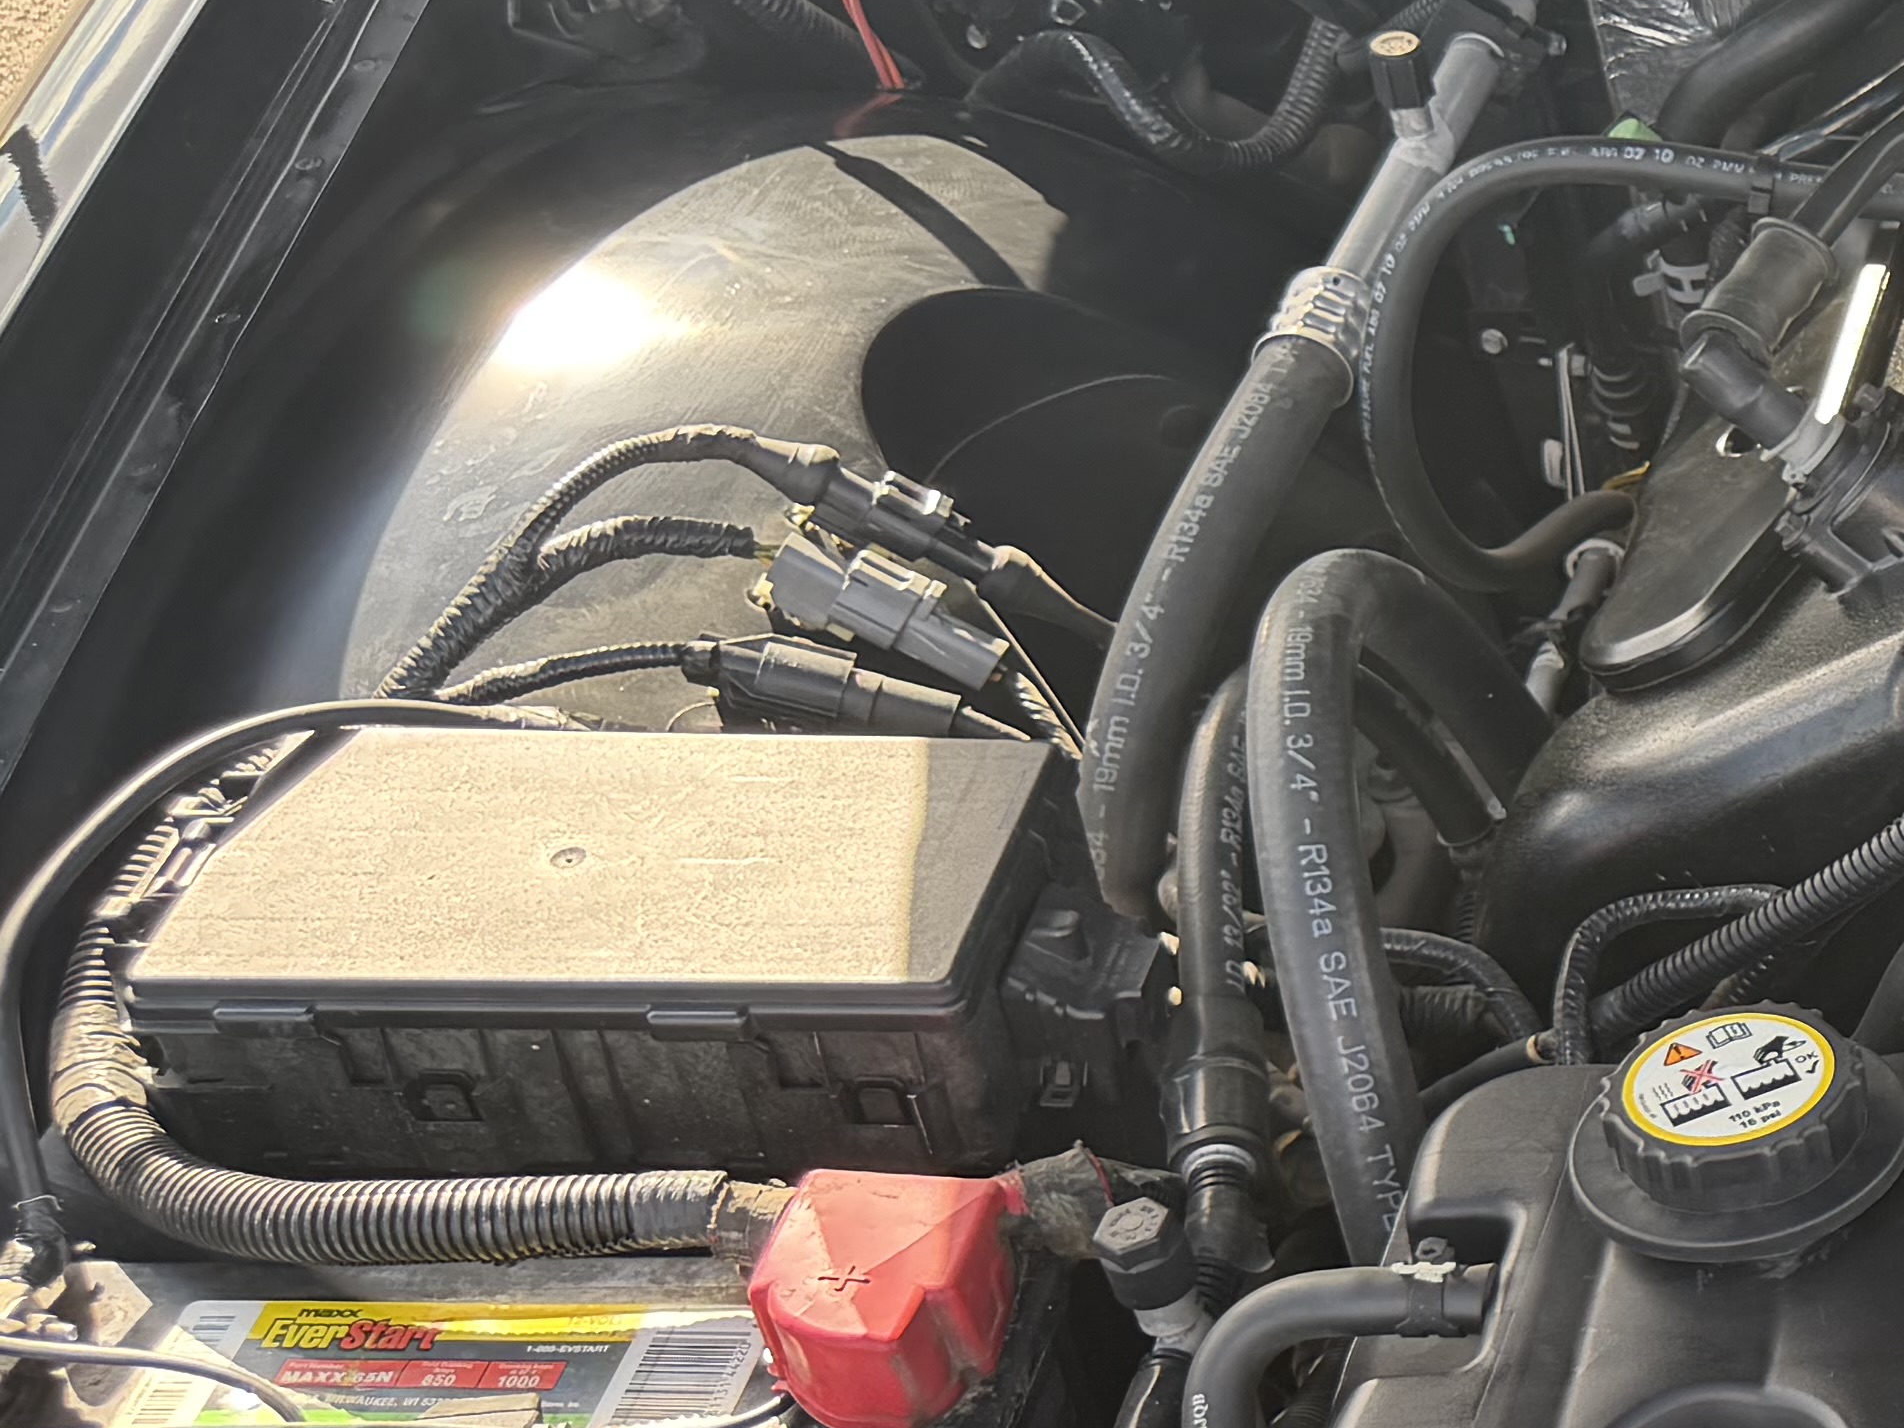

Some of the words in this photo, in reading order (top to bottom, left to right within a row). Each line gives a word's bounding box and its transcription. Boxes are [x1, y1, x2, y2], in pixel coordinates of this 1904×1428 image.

[1091, 716, 1131, 791] 19mm
[1115, 668, 1143, 711] I.D.
[1162, 492, 1216, 563] R134a
[1200, 438, 1241, 488] SAE
[1282, 624, 1315, 687] 19mm
[1298, 844, 1337, 938] R134a
[1319, 951, 1357, 1021] SAE
[1795, 1052, 1819, 1063] OK
[1336, 1035, 1386, 1134] J2064
[1729, 1110, 1751, 1123] 110
[261, 1317, 443, 1351] EverStart
[298, 1309, 363, 1318] maxx
[420, 1374, 456, 1386] 850
[497, 1375, 539, 1389] 1000
